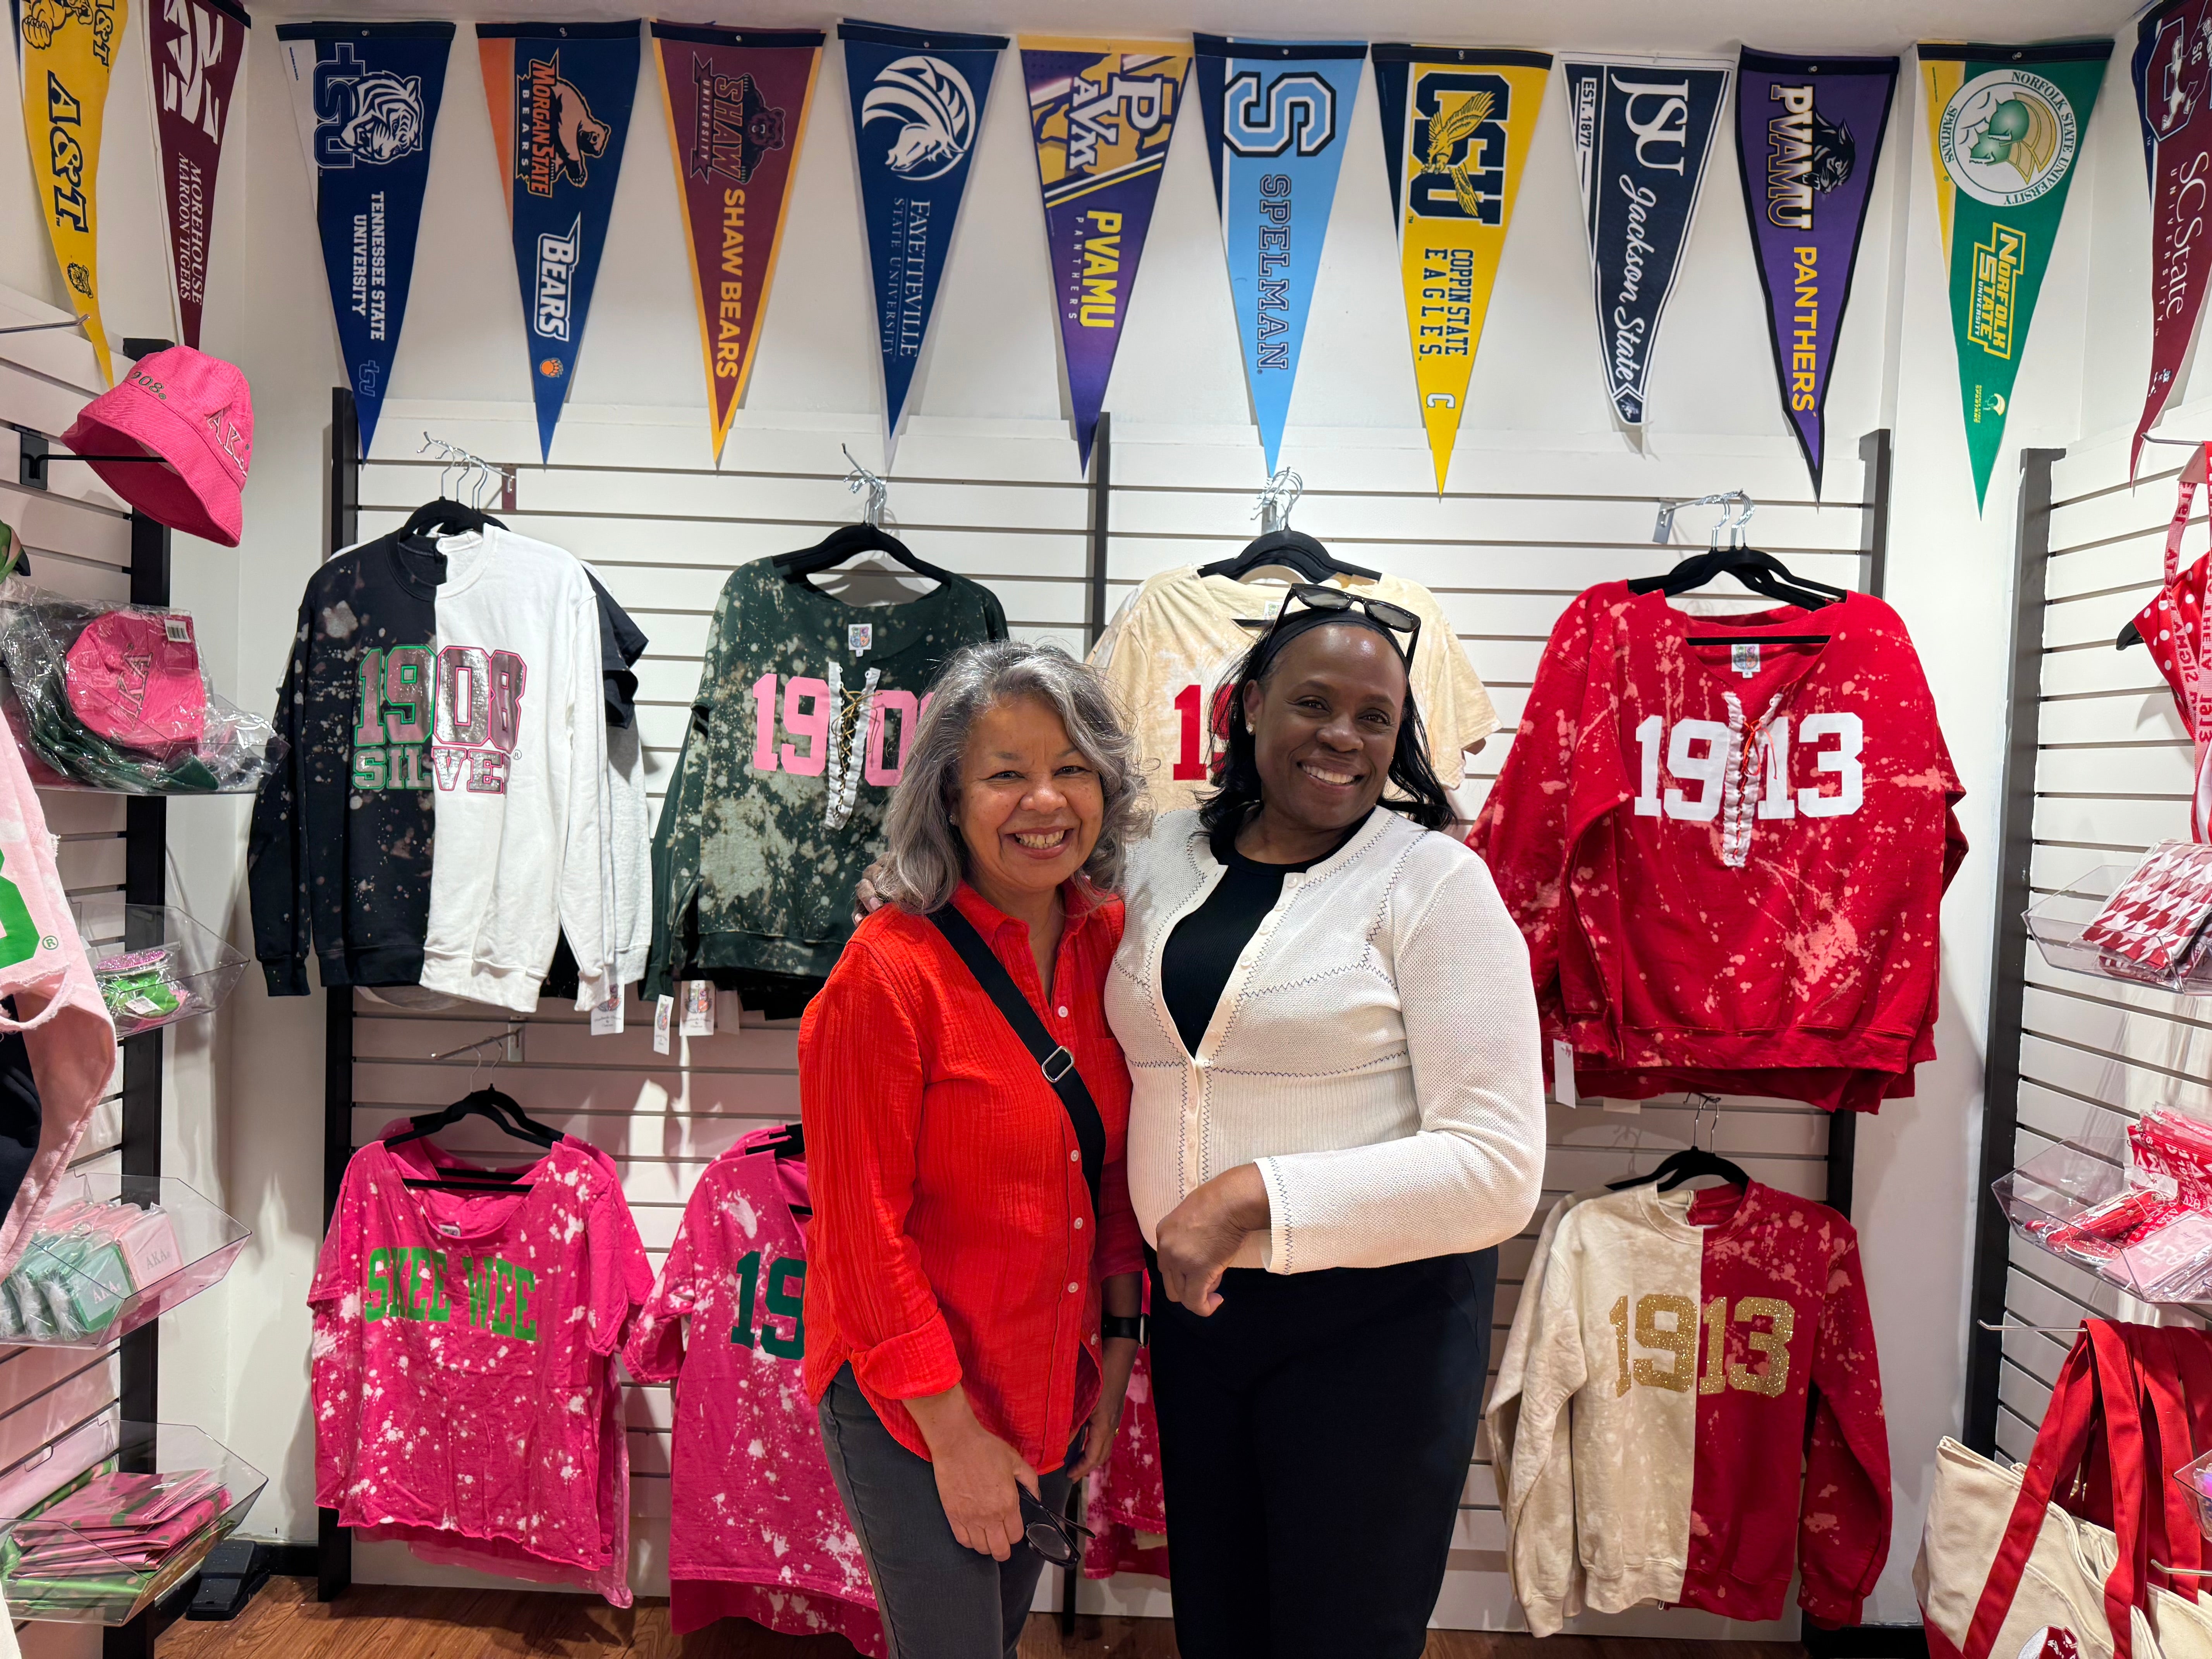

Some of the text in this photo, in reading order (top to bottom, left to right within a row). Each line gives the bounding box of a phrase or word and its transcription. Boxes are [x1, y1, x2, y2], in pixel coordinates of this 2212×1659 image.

[2191, 41, 2202, 65] SC
[48, 70, 89, 233] A&T
[521, 89, 530, 167] BEARS
[701, 80, 711, 160] UNIVERSITY
[712, 77, 743, 179] SHAW
[1222, 71, 1336, 158] S
[1580, 81, 1595, 148] EST. 1877
[1611, 73, 1689, 176] JSU
[1768, 84, 1814, 230] PVAMU
[1941, 105, 1958, 163] SPARTANS
[2003, 71, 2075, 205] NORFOLK STATE UNIVERSITY
[179, 152, 191, 301] MAROON TIGERS
[190, 161, 202, 306] MOREHOUSE
[352, 215, 367, 316] UNIVERSITY
[371, 191, 385, 341] TENNESSEE STATE
[883, 198, 904, 355] STATE UNIVERSITY
[900, 199, 931, 357] FAYETTEVILLE
[1068, 216, 1084, 319] PANTHERS
[1080, 210, 1122, 328] PVAMU
[1257, 174, 1291, 370] SPELMAN
[1614, 174, 1657, 381] Jackson State
[2157, 168, 2178, 322] UNIVERSITY
[539, 234, 575, 340] BEARS
[716, 188, 745, 378] SHAW BEARS
[1419, 248, 1448, 355] EAGLES
[1445, 249, 1474, 356] COPPIN STATE
[1792, 247, 1818, 411] PANTHERS
[1974, 281, 1984, 337] UNIVERSITY
[1979, 252, 1997, 340] STATE
[1993, 232, 2018, 349] NORFOLK
[1426, 393, 1456, 409] C
[354, 644, 527, 754] 1908
[753, 673, 934, 786] 190
[352, 745, 511, 795] SILVE
[365, 1247, 537, 1341] SKEE WEE
[1609, 1293, 1795, 1398] 1913
